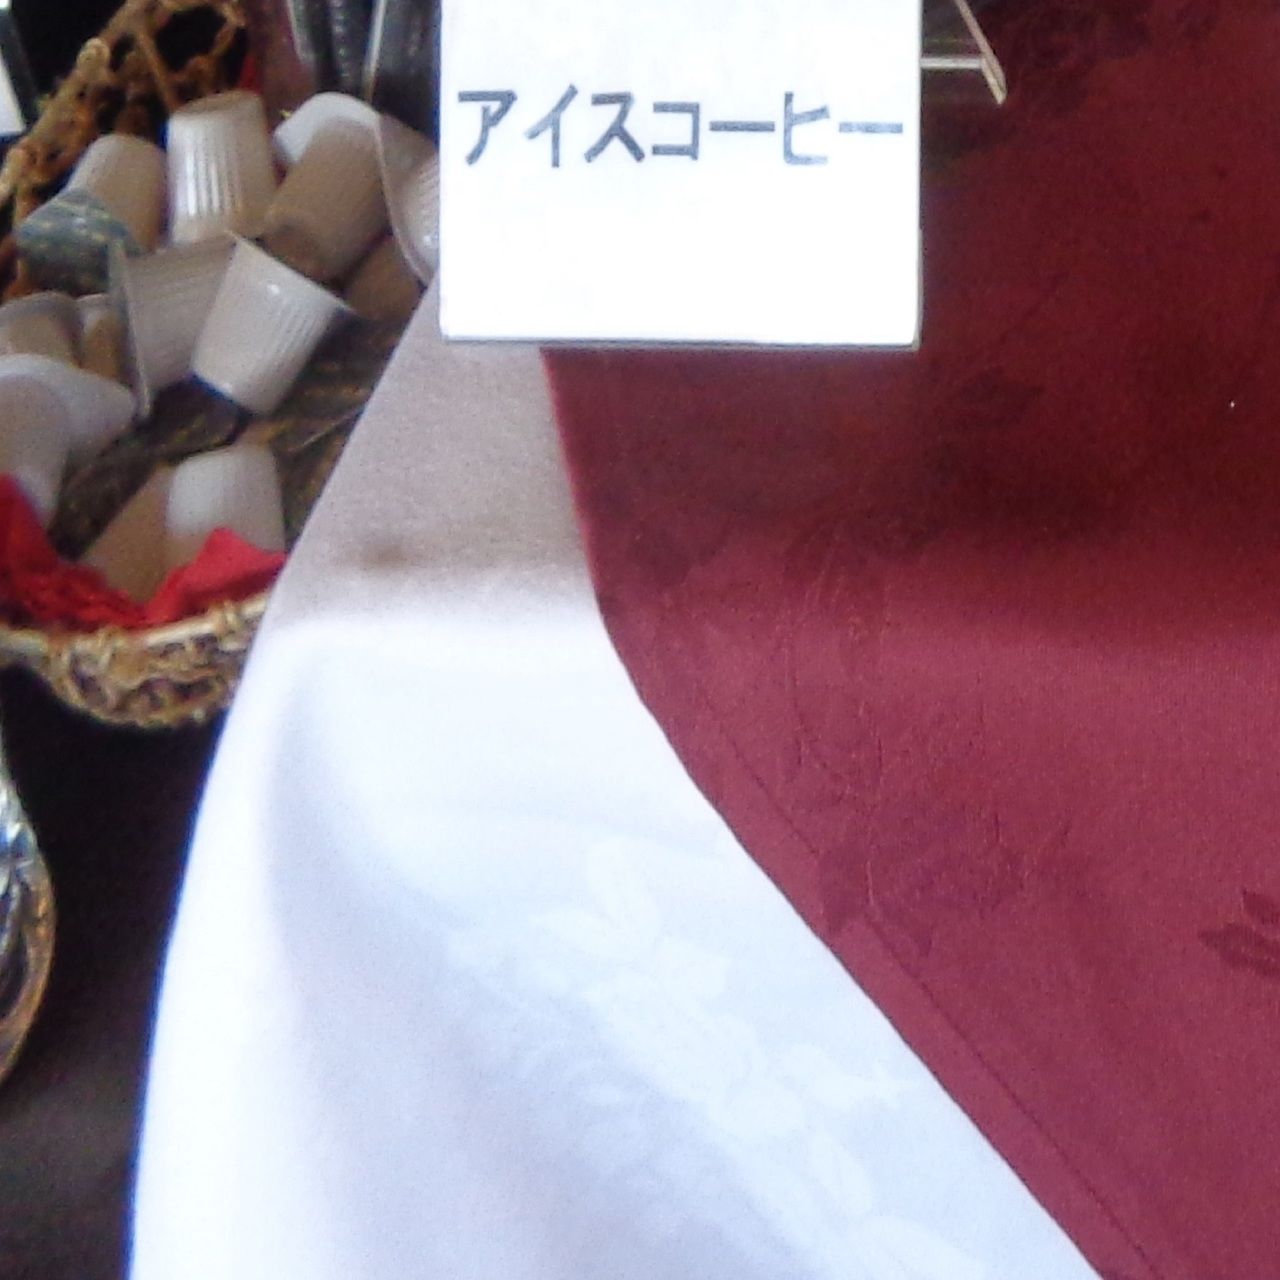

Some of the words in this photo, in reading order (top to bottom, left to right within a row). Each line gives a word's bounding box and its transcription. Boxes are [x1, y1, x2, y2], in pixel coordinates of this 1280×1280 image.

[457, 84, 904, 170] アイスコーヒー
